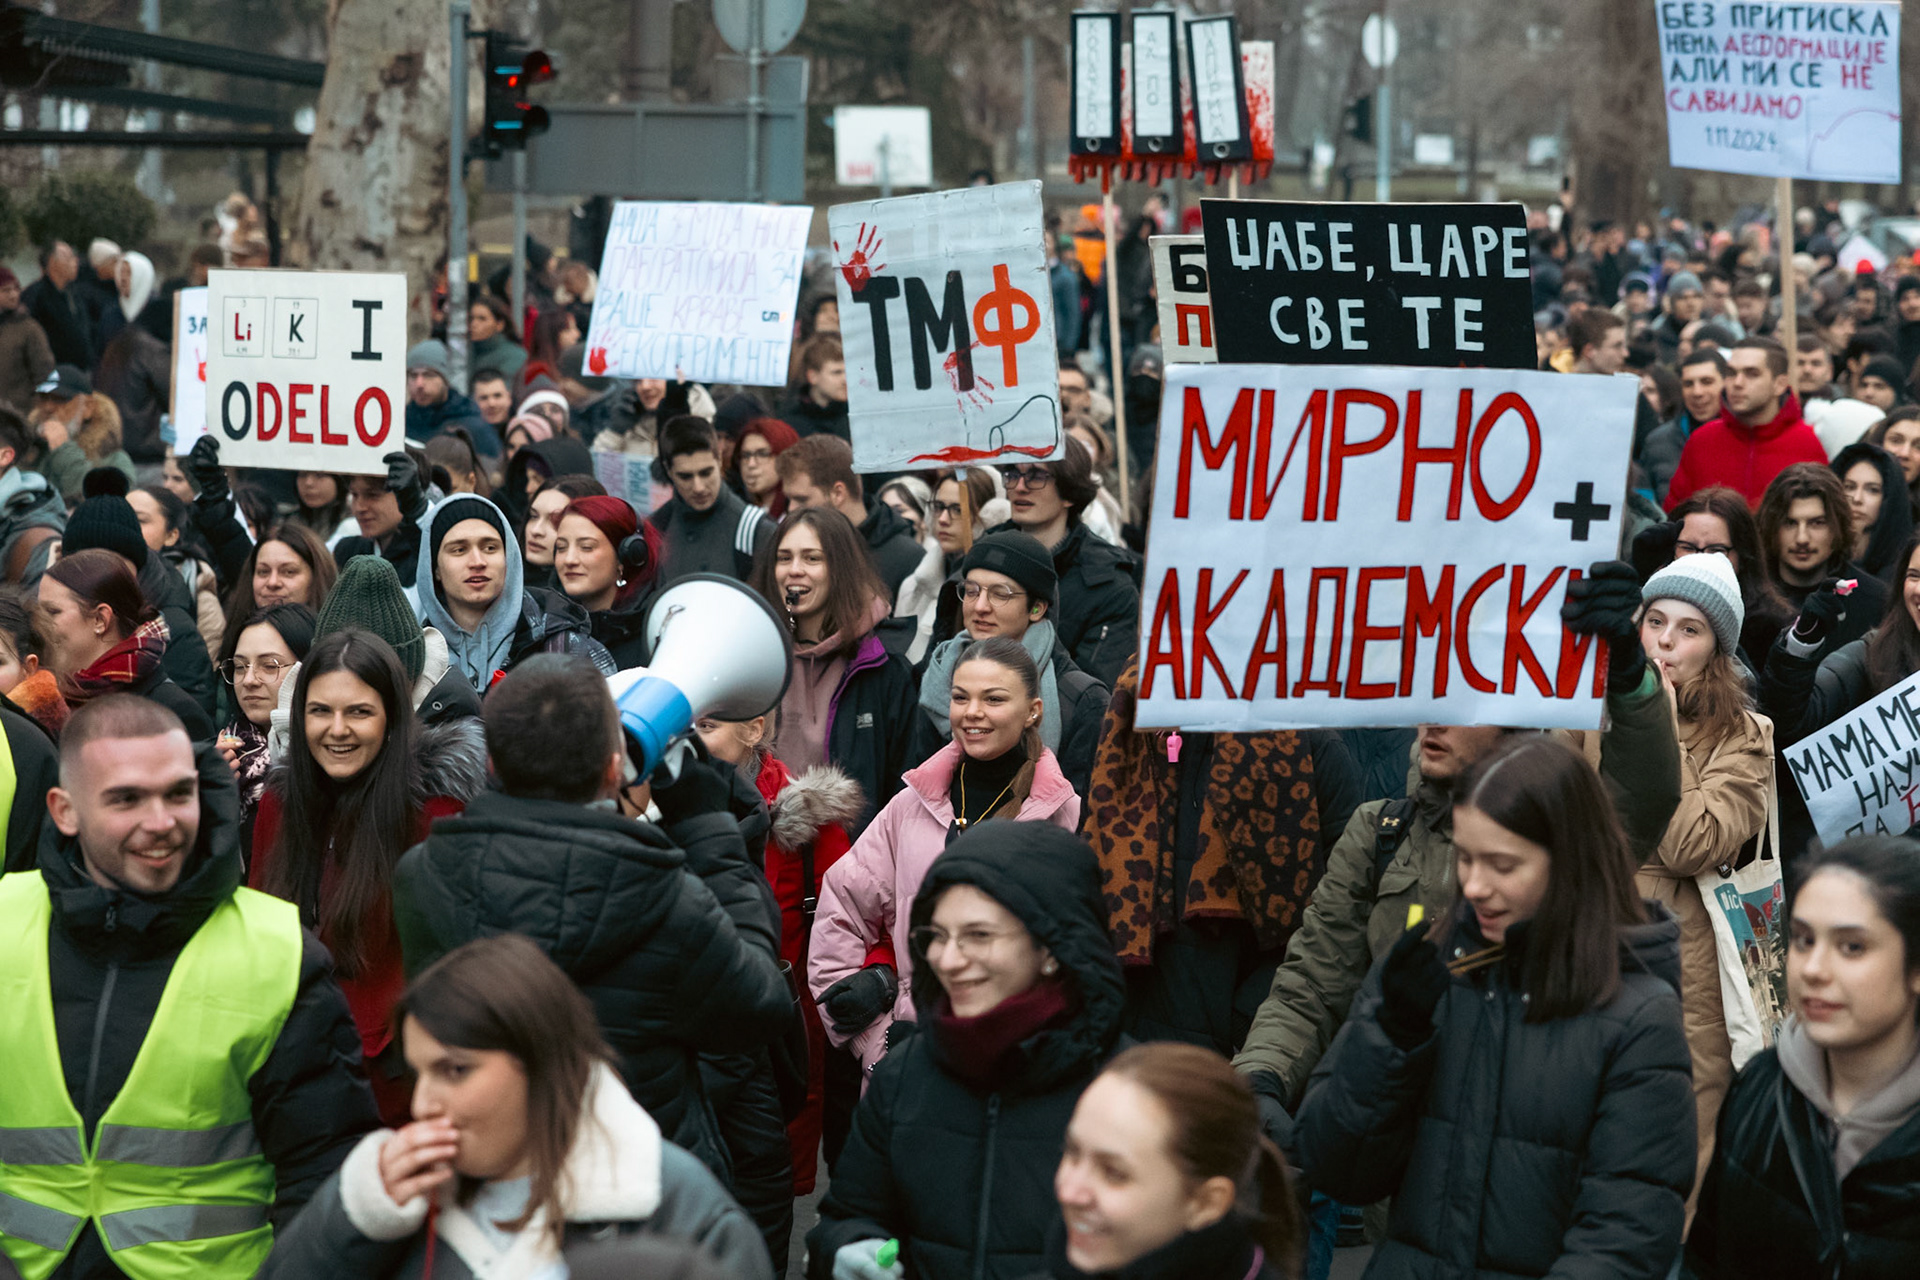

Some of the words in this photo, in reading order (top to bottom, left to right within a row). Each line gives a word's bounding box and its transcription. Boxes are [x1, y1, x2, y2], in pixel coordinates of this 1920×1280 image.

[1662, 2, 1715, 30] БЕЗ
[1730, 3, 1890, 37] ПРИТИСКА
[1665, 32, 1719, 55] НЕМА
[1723, 33, 1887, 64] ДЕФОРМАЦИЈЕ
[1669, 57, 1731, 84] АЛИ
[1742, 60, 1779, 87] МИ
[1789, 62, 1822, 88] СЕ
[1840, 64, 1875, 91] НЕ
[1668, 88, 1803, 120] САВИЈАМО
[1387, 222, 1531, 279] ЦАРЕ
[234, 312, 252, 342] Li
[288, 313, 305, 343] K
[350, 299, 383, 361] I
[594, 288, 664, 329] ВАШЕ
[851, 263, 1042, 392] ТМФ
[1268, 295, 1369, 351] СВЕ
[1401, 296, 1485, 352] ТЕ
[221, 380, 392, 448] ODELO
[1174, 386, 1542, 522] МИРНО
[1139, 563, 1610, 701] АКАДЕМСКИ
[1788, 717, 1889, 801] МАМА
